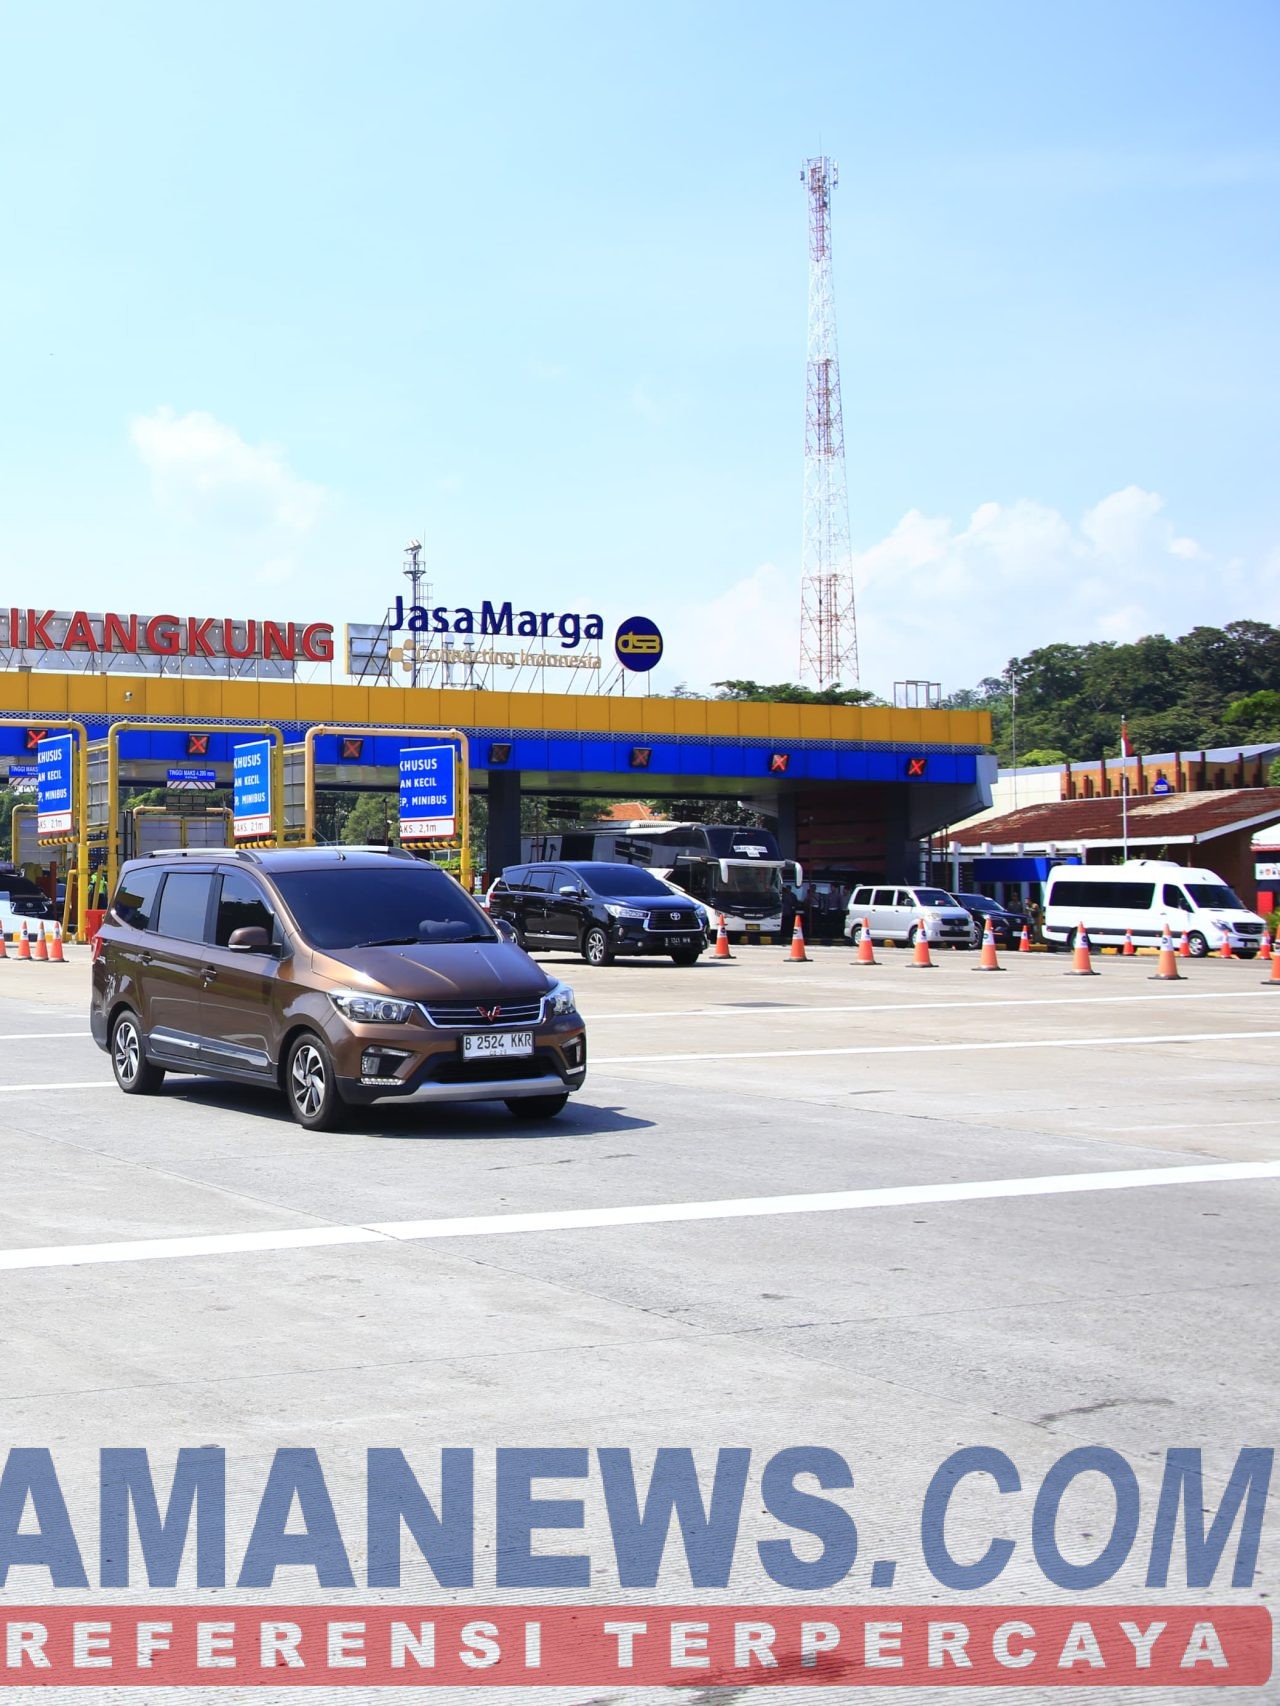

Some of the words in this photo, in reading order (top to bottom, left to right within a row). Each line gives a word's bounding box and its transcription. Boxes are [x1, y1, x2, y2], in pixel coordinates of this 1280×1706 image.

[389, 596, 603, 648] JasaMarga
[234, 753, 261, 769] KHUSUS
[47, 769, 62, 781] KECIL
[244, 774, 260, 786] KECIL
[414, 777, 438, 788] KECIL
[45, 788, 67, 801] MINIBUS
[242, 792, 266, 805] MINIBUS
[411, 795, 447, 806] MINIBUS
[465, 1037, 472, 1050] B
[477, 1034, 505, 1050] 2524
[511, 1033, 532, 1048] KKR
